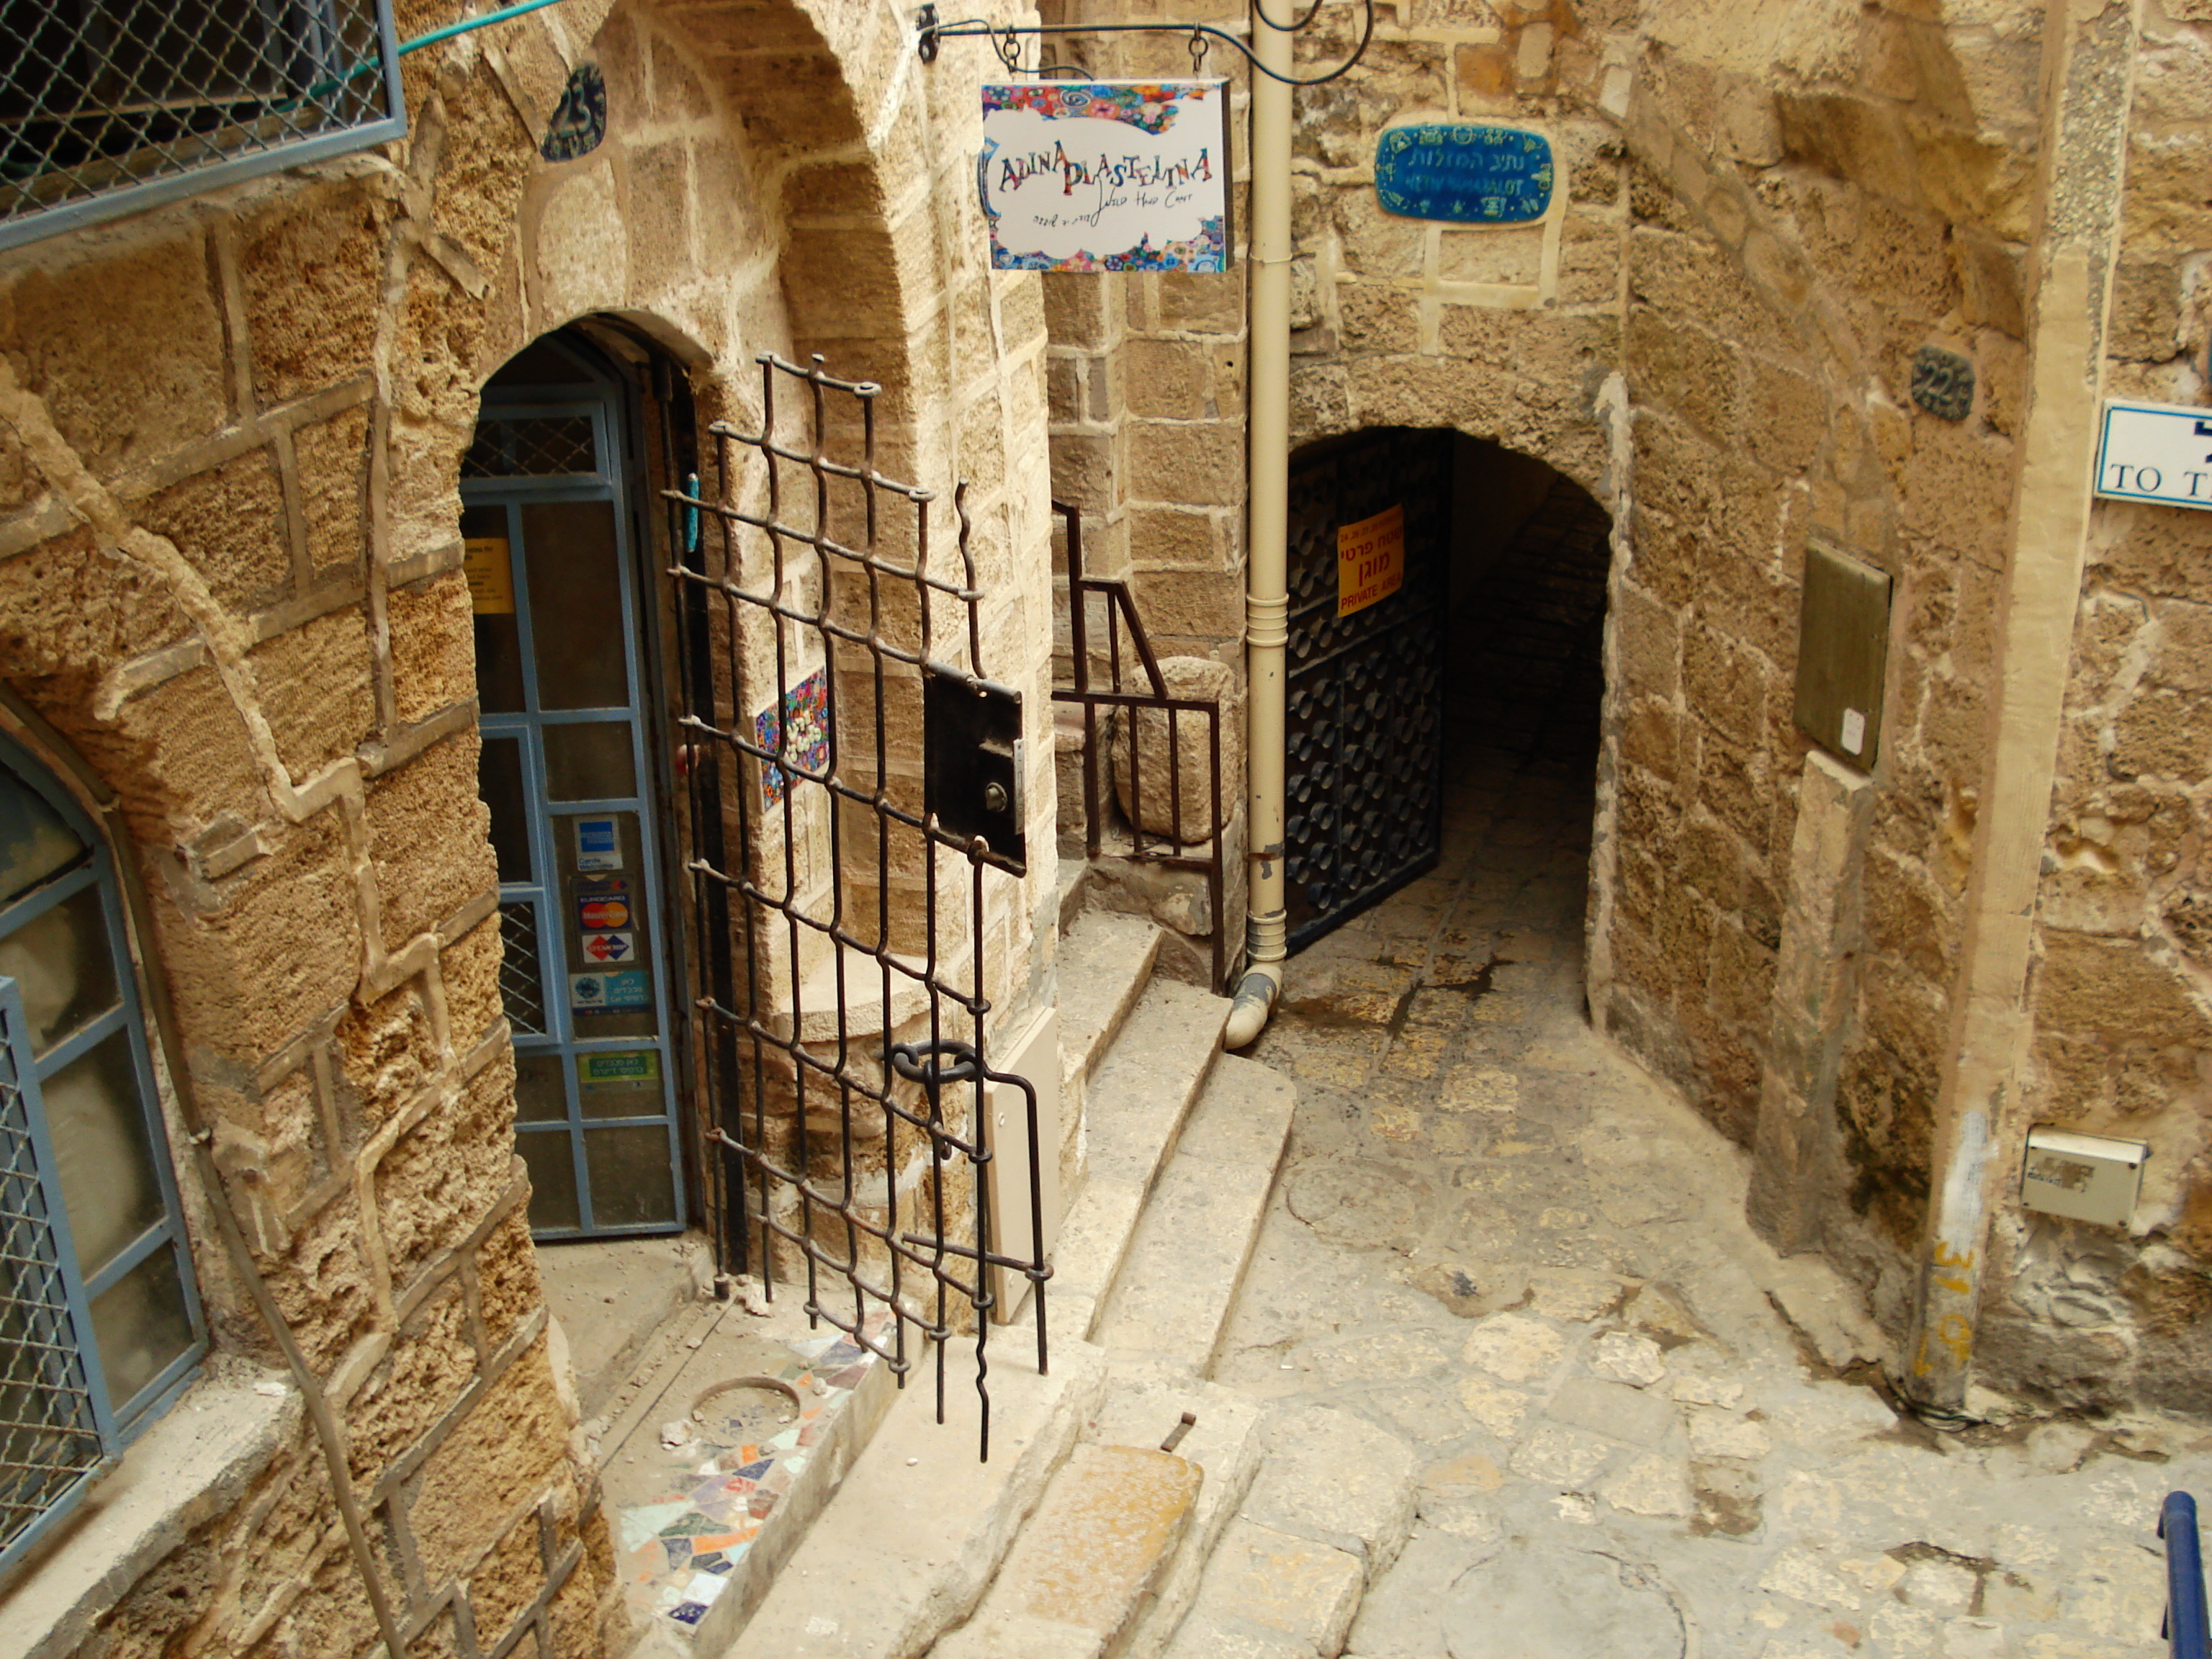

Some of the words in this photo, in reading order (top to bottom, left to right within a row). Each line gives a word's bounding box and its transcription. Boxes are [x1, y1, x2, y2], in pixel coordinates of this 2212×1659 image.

[999, 139, 1067, 192] ADINA
[1064, 147, 1213, 196] PLASTELINA
[1408, 147, 1483, 169] המזלות
[1488, 153, 1525, 172] נתיב
[1913, 360, 1954, 402] 22
[2110, 464, 2162, 493] TO
[1377, 525, 1402, 548] שטח
[1340, 541, 1374, 562] פרטי
[1359, 552, 1390, 588] מוגן
[1341, 584, 1377, 611] PRIVATE
[1381, 571, 1402, 591] AREA
